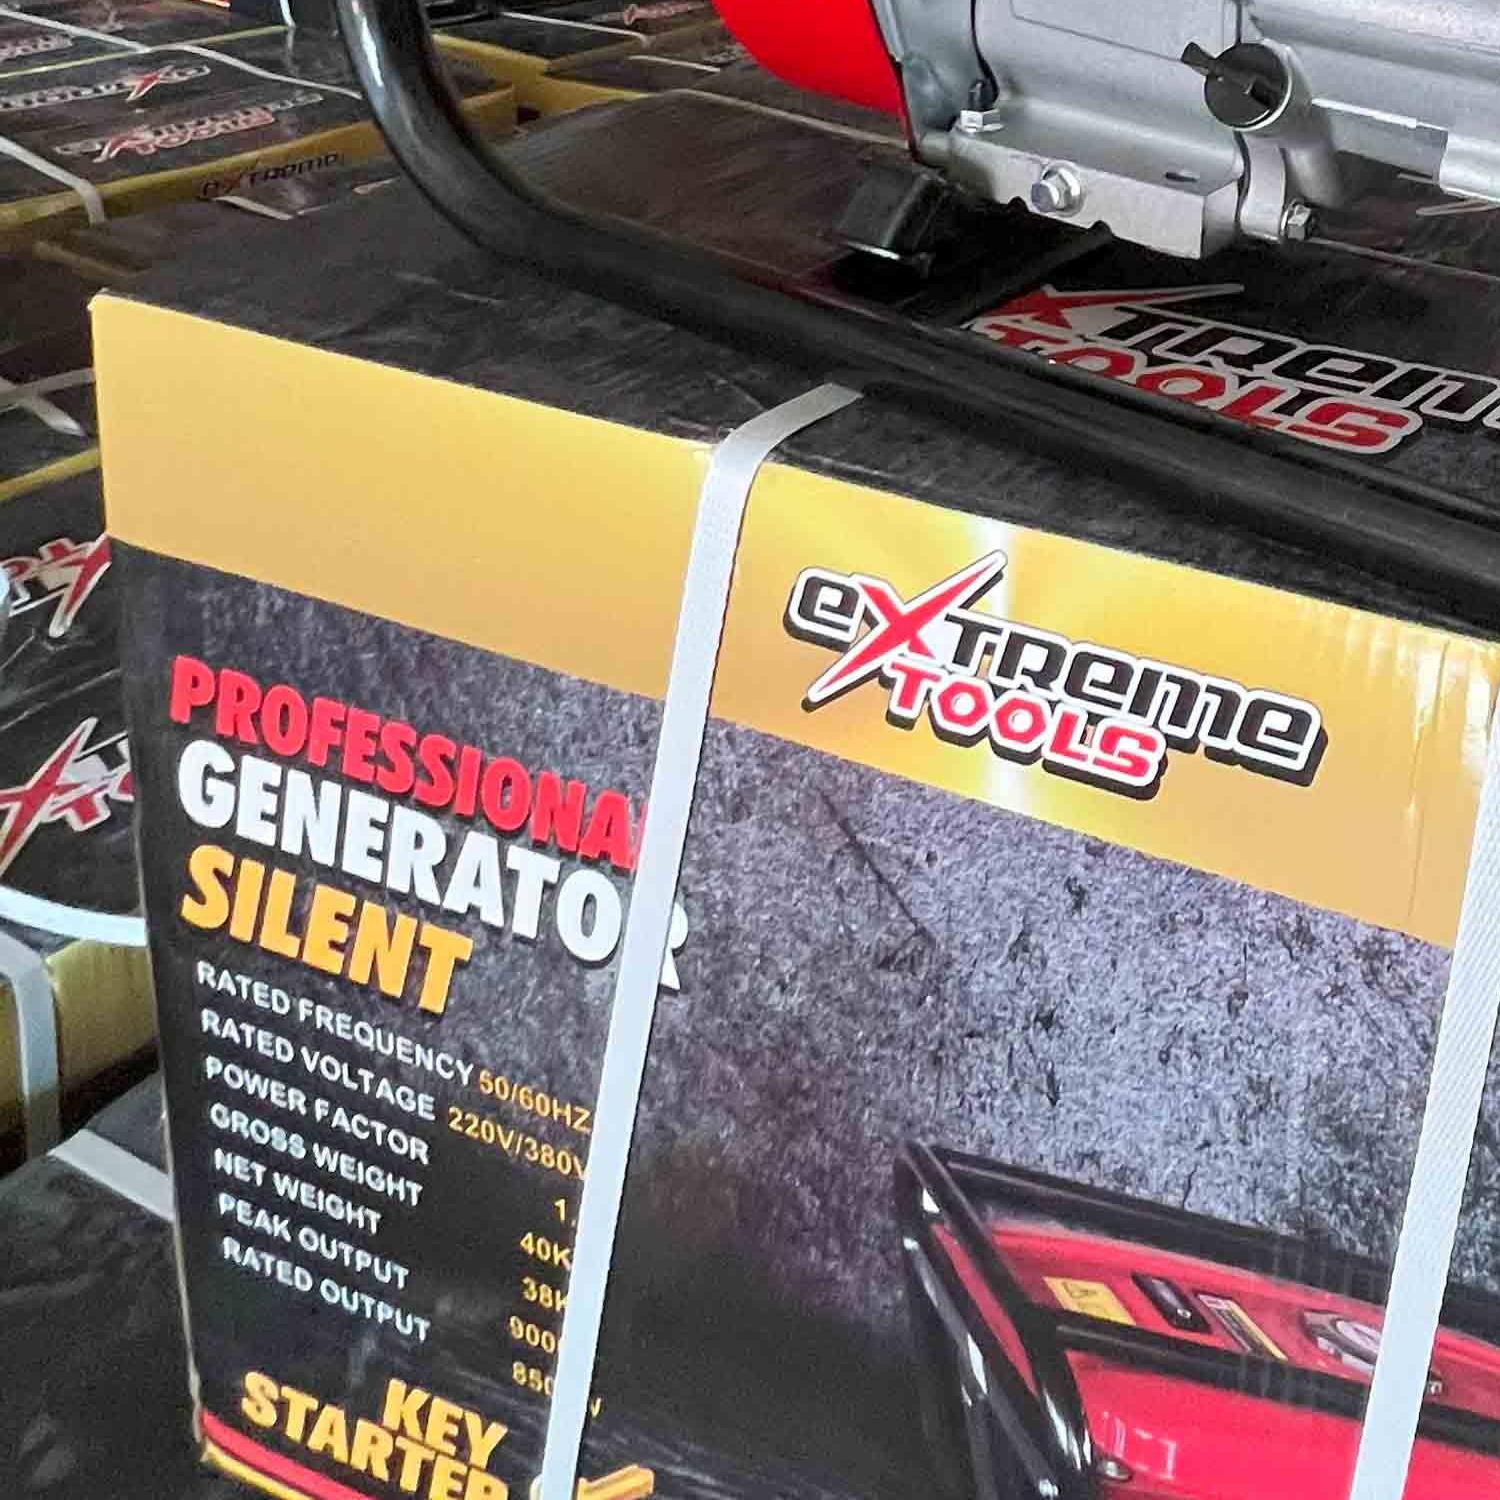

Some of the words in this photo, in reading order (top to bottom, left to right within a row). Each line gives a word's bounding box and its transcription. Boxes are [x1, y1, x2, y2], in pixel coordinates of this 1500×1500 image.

[169, 654, 647, 871] PROFESSIONA
[878, 658, 1167, 800] TOOLS
[181, 844, 474, 1014] SILENT
[197, 961, 291, 1016] RATED
[297, 999, 475, 1088] FREQUENCY
[478, 1068, 594, 1135] 50/60HZ
[201, 1008, 295, 1064] RATED
[301, 1046, 437, 1122] VOLTAGE
[447, 1104, 593, 1182] 220V/380V
[205, 1055, 308, 1116] POWER
[314, 1098, 431, 1165] FACTOR
[209, 1101, 307, 1160] GROSS
[313, 1142, 424, 1207] WEIGHT
[519, 1231, 572, 1271] 40K
[213, 1147, 266, 1188] NET
[272, 1170, 382, 1235] WEIGHT
[521, 1276, 568, 1315] 38K
[218, 1192, 292, 1244] PEAK
[298, 1227, 410, 1290] OUTPUT
[221, 1236, 314, 1293] RATED
[319, 1278, 432, 1342] OUTPUT
[241, 1371, 509, 1500] STARTER
[381, 1377, 508, 1468] KEY
